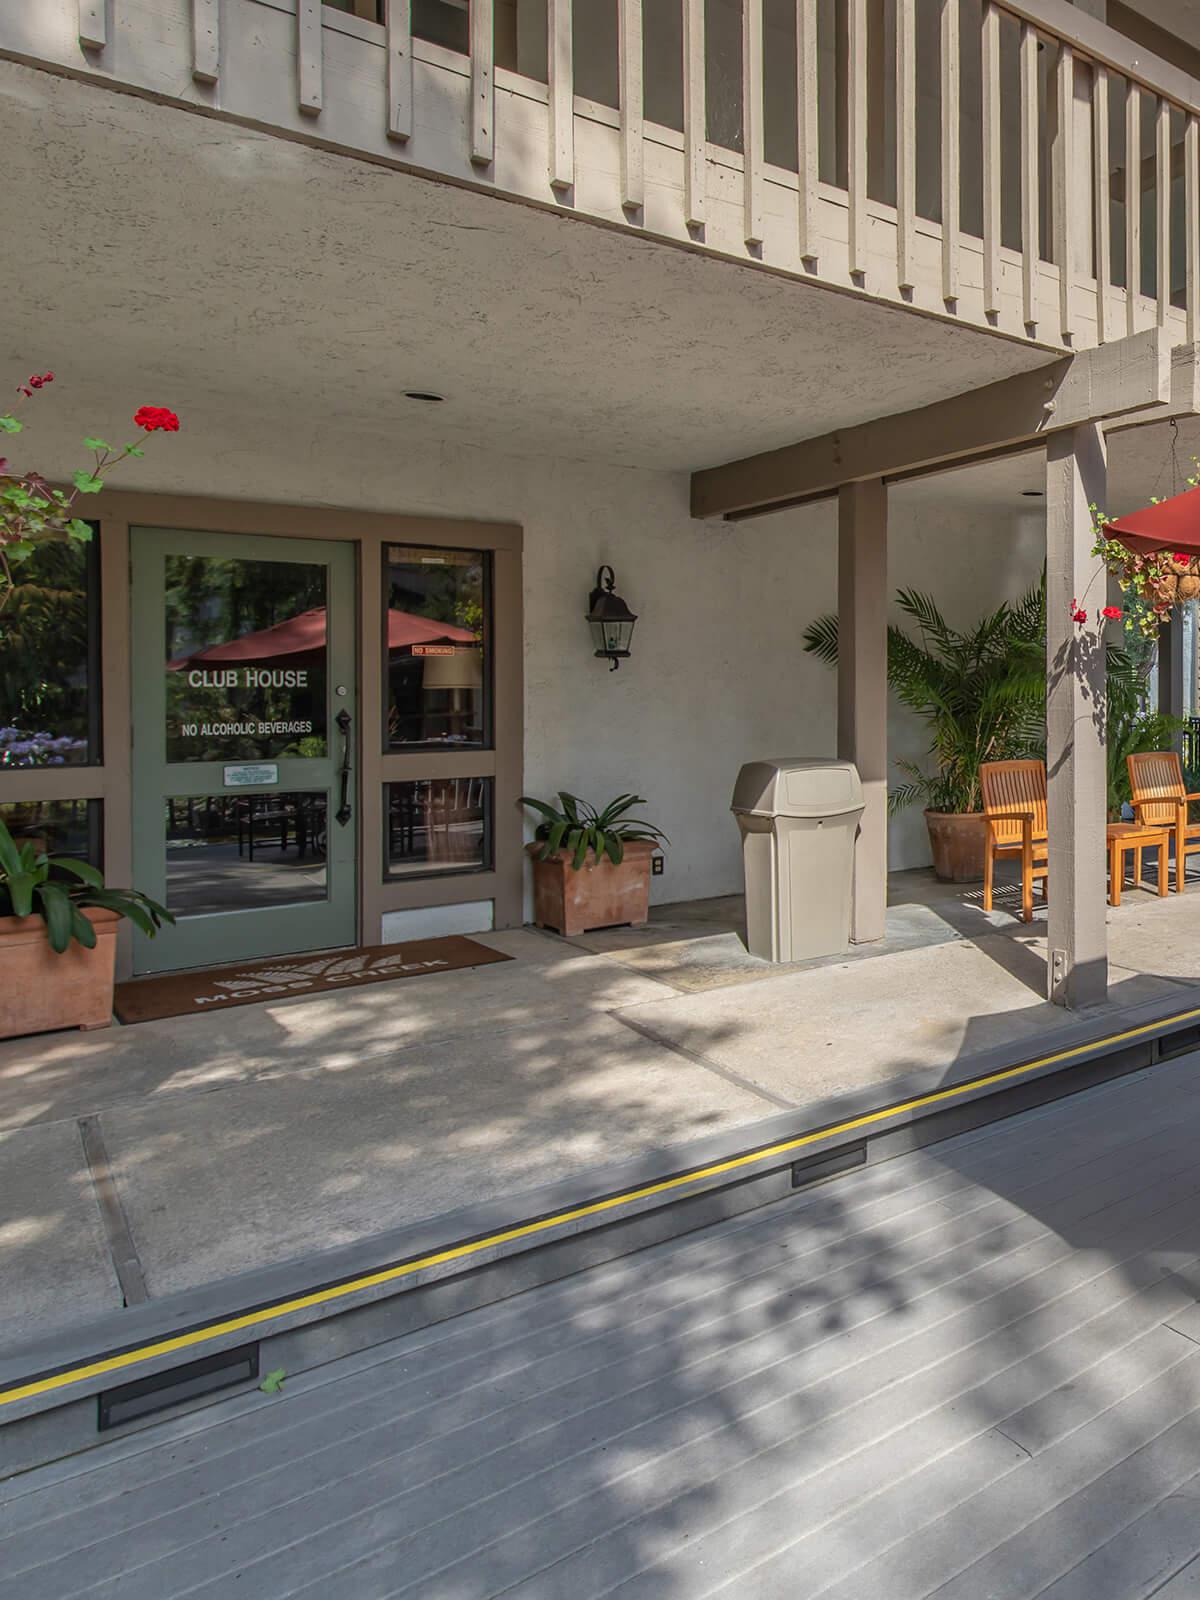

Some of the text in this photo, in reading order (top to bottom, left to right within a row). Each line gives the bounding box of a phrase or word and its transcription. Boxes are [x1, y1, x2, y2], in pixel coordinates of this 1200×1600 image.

[188, 670, 308, 688] CLUB HOUSE
[182, 720, 312, 737] NO ALCOHOLIC BEVERAGES
[194, 981, 314, 1005] MOSS
